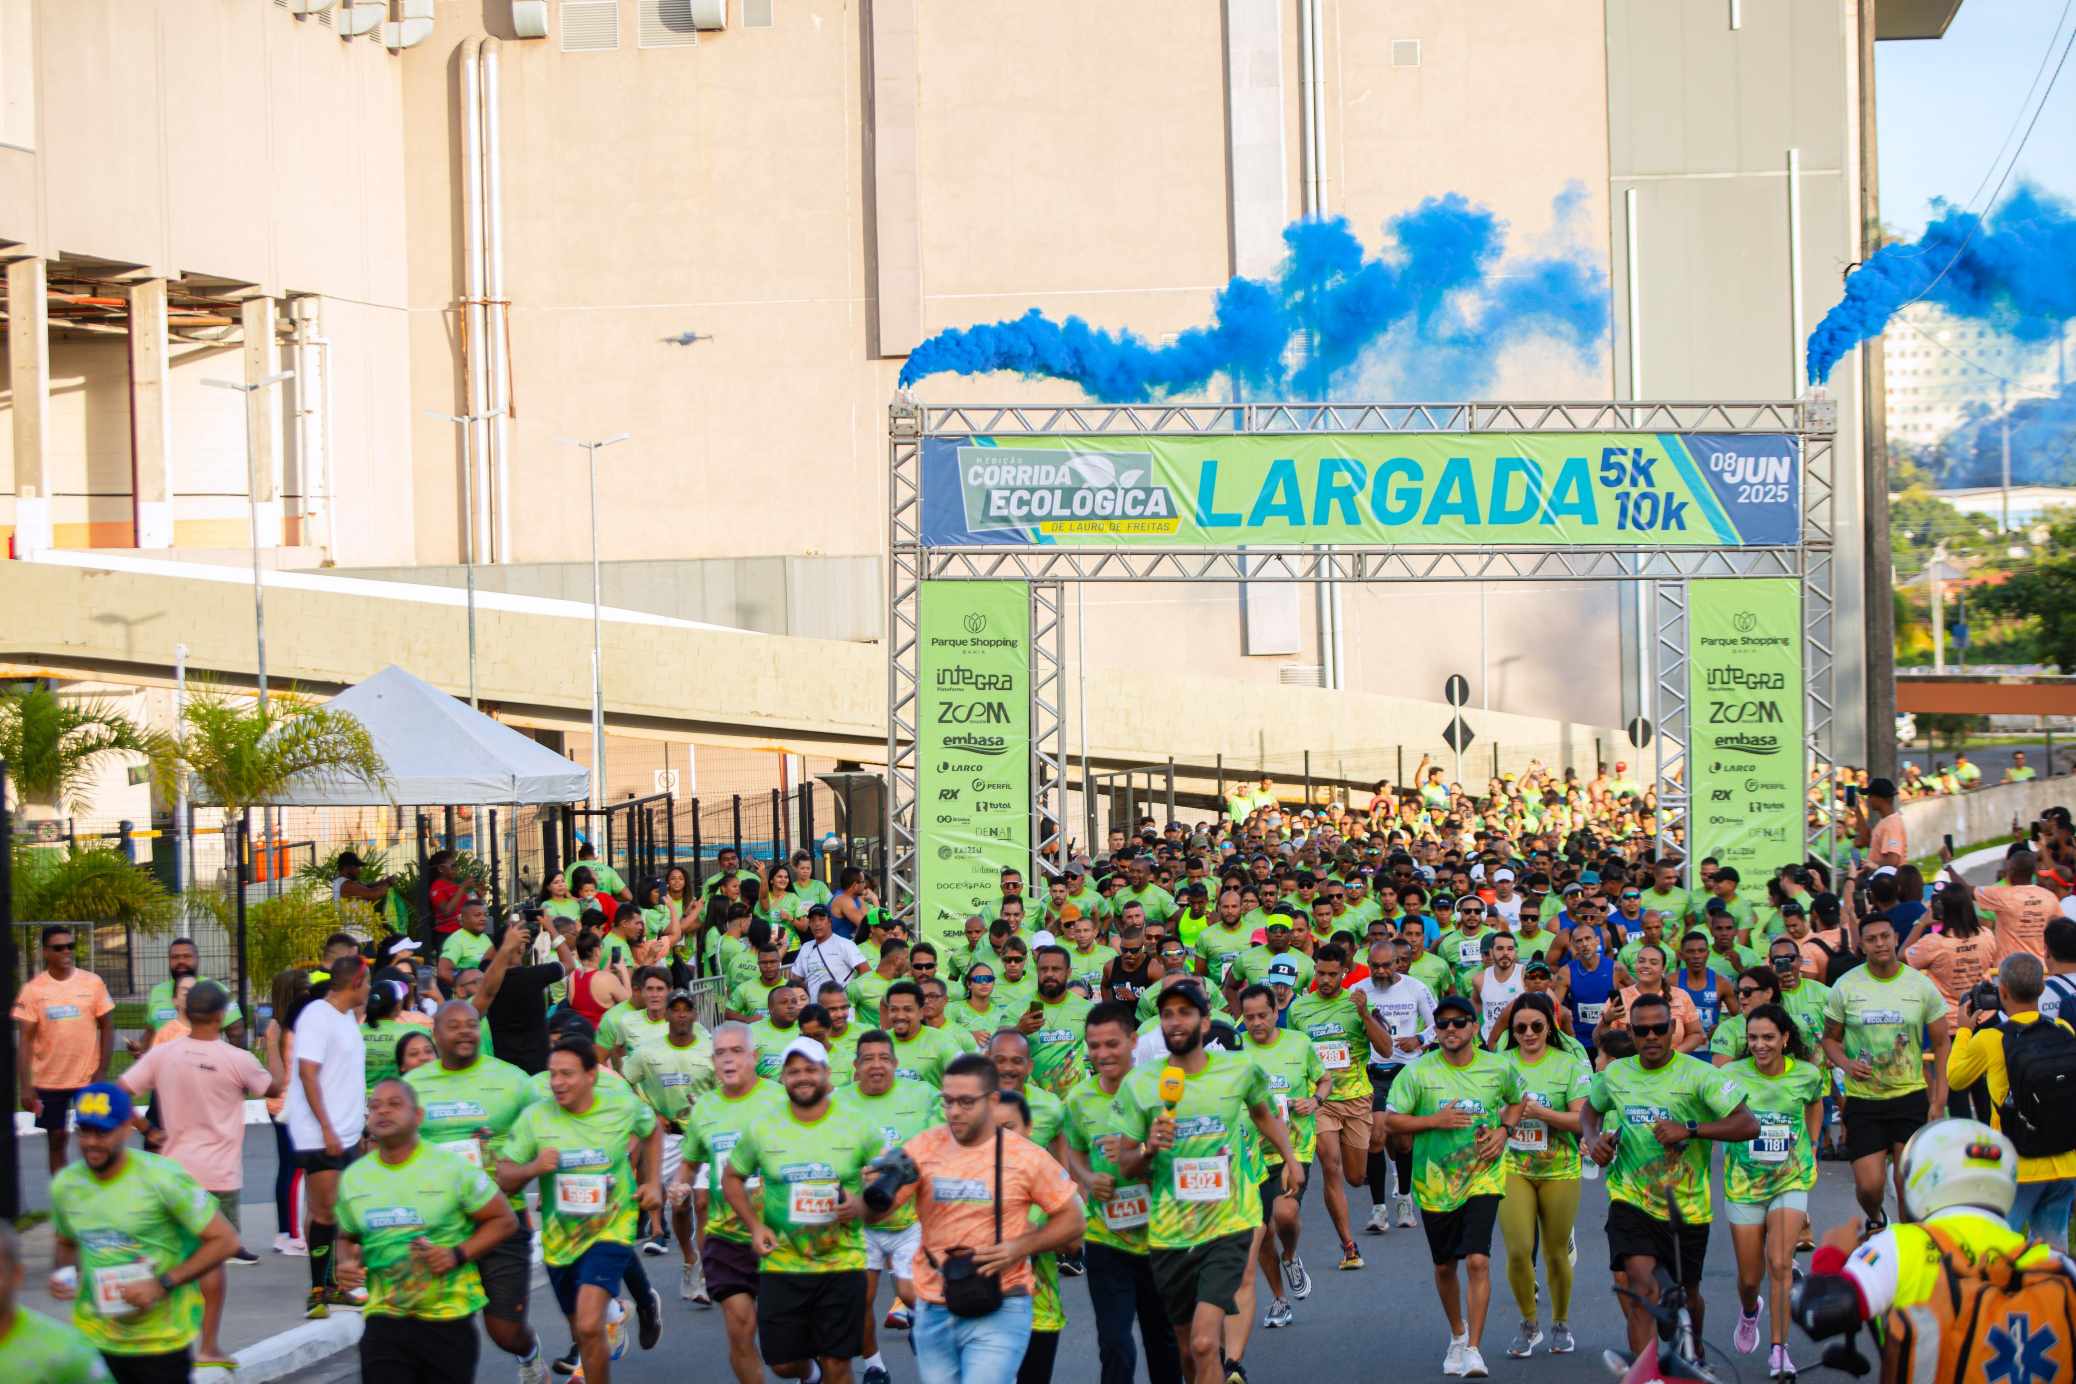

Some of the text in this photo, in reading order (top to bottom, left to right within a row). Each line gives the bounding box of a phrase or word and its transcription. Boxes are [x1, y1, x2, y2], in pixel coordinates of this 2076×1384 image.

[968, 465, 1072, 486] CORRIDA
[1599, 447, 1659, 488] 5k
[1709, 452, 1792, 484] 08 JUN
[990, 485, 1170, 516] ECOLÓGICA
[1197, 458, 1599, 527] LARGADA
[1736, 485, 1790, 503] 2025
[1615, 491, 1690, 531] 10k
[1127, 522, 1170, 531] FREITAS
[931, 637, 1018, 648] Parque Shopping
[1701, 636, 1790, 646] Parque Shopping
[938, 701, 1011, 724] ZOOM
[1709, 701, 1784, 724] ZOOM
[943, 732, 1005, 746] embasa
[1714, 732, 1778, 746] embasa
[952, 764, 983, 772] LARCO
[938, 788, 960, 800] RX
[1711, 789, 1733, 801] RX
[973, 881, 992, 889] PÃO
[1515, 1128, 1537, 1144] 410
[1763, 1138, 1785, 1152] 1181
[1187, 1172, 1217, 1189] 502
